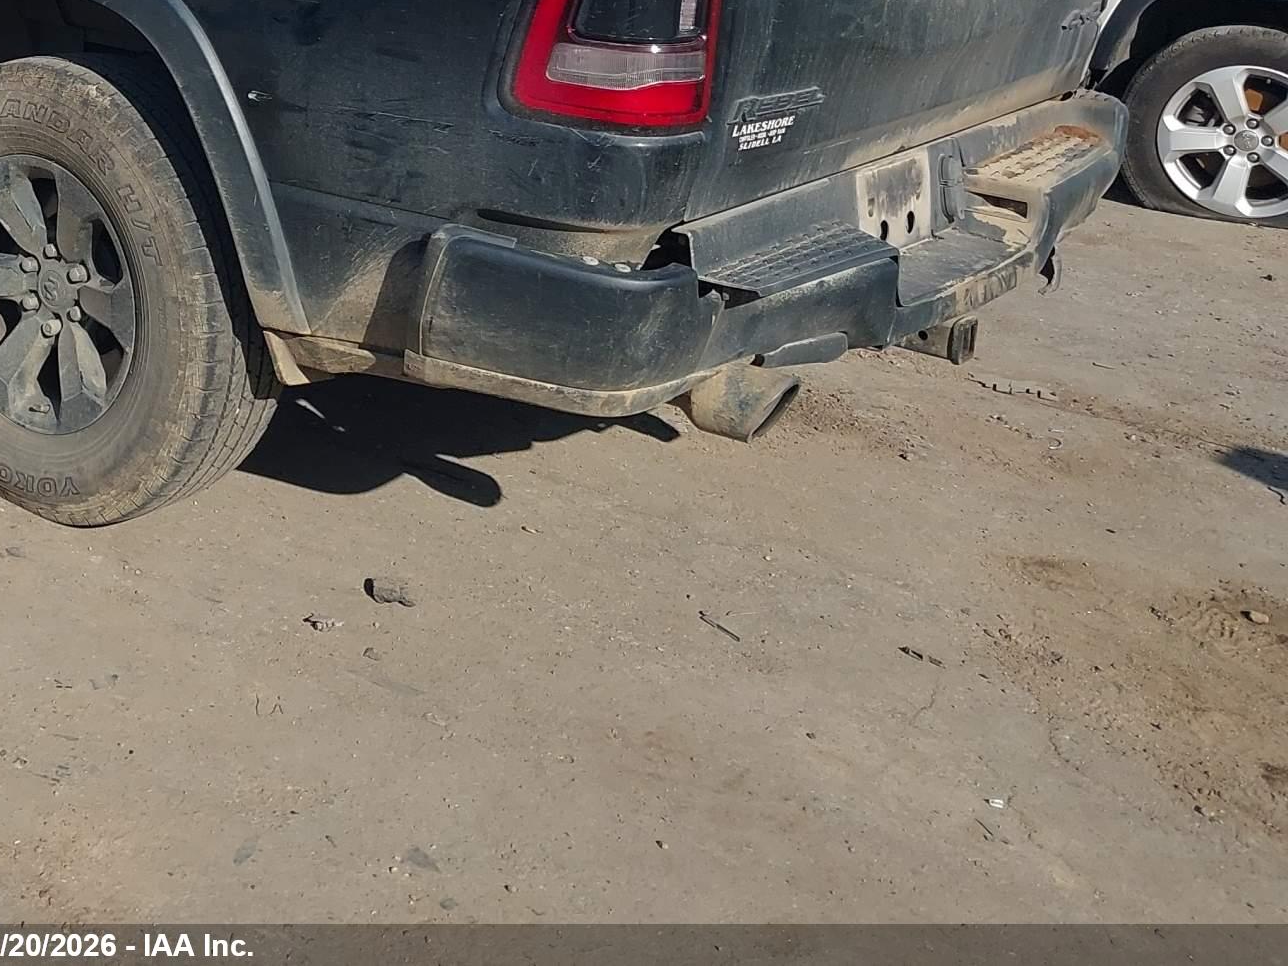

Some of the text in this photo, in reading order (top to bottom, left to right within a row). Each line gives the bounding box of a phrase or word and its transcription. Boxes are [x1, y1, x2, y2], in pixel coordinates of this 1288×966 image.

[732, 115, 795, 137] LAKESHORE
[738, 138, 769, 151] SLIDELL
[772, 135, 782, 144] LA
